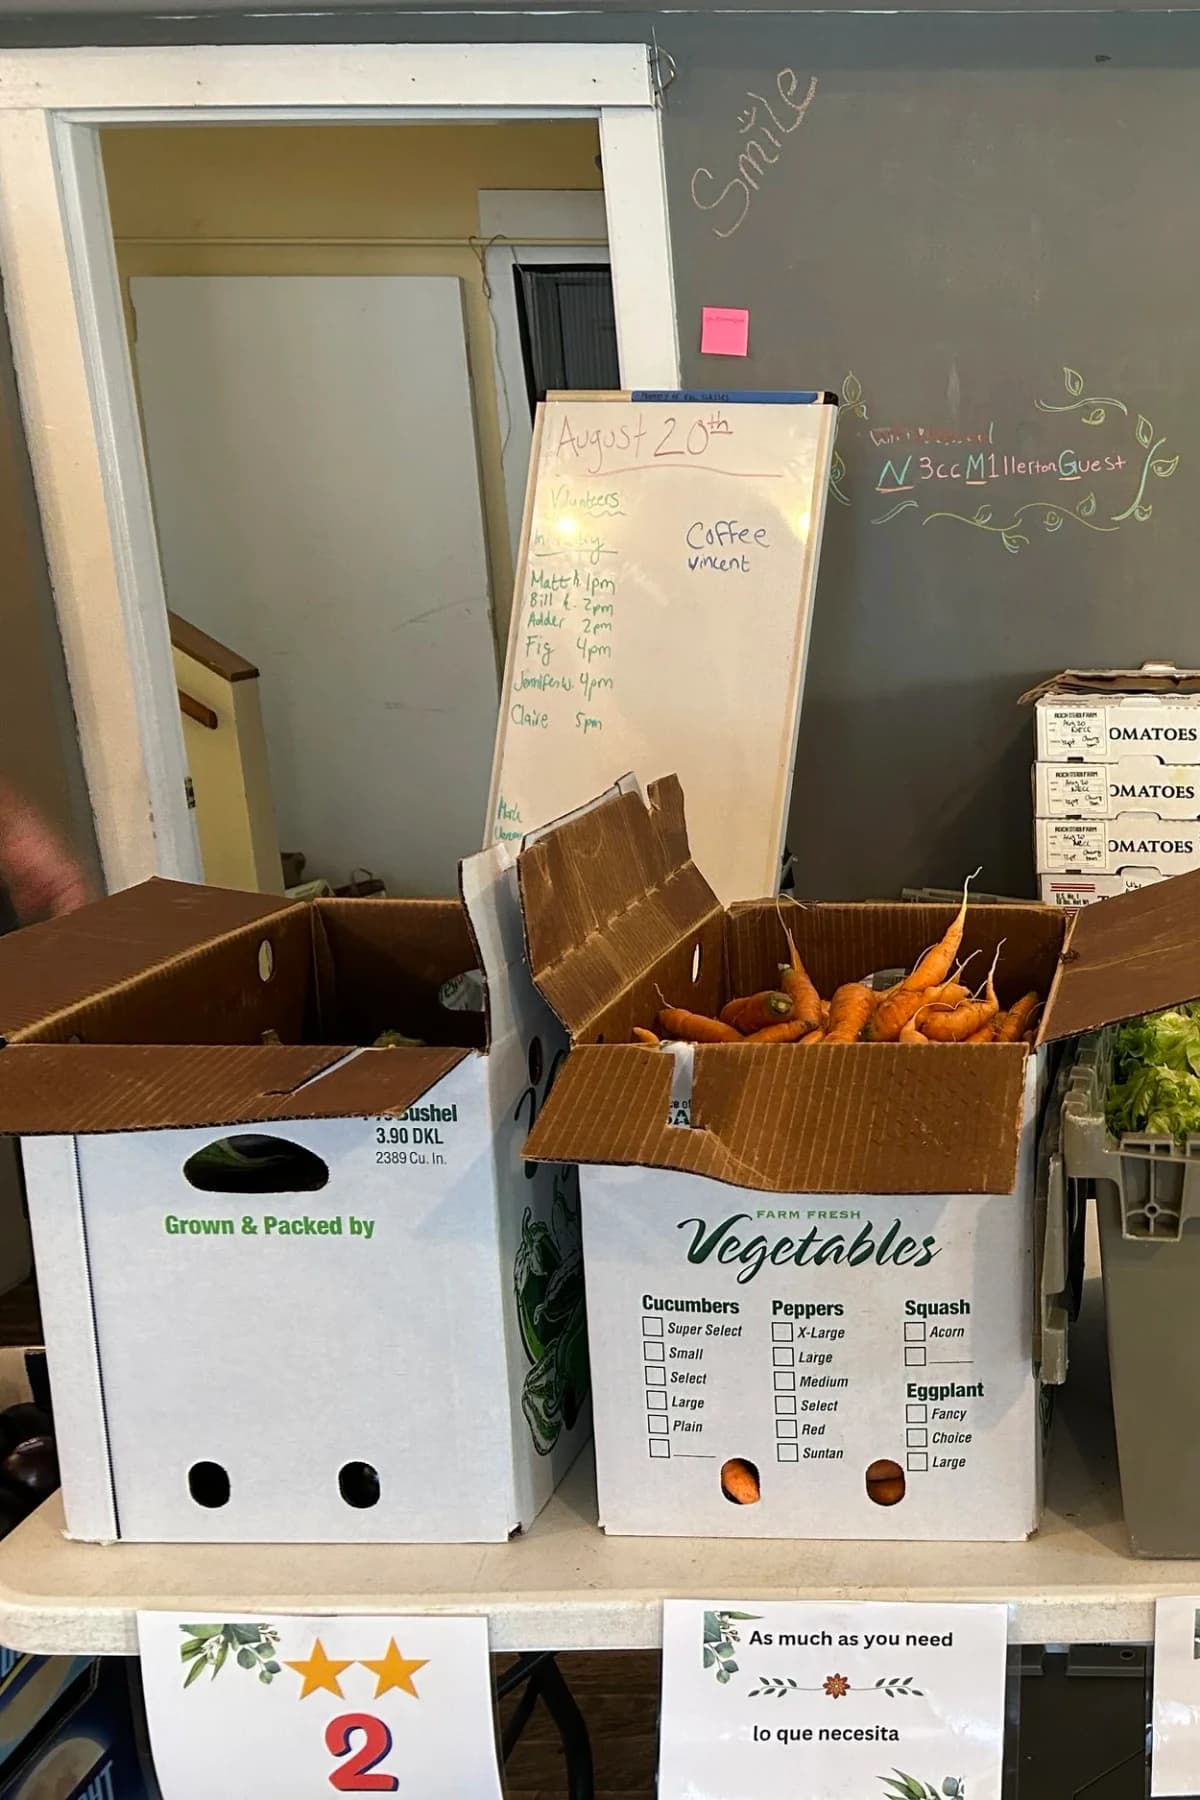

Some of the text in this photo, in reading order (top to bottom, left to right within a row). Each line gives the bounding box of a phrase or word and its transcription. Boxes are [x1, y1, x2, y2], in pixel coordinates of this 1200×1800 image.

[691, 68, 818, 239] Smile
[557, 413, 647, 473] August
[686, 520, 770, 550] Coffee
[530, 591, 552, 608] Bill
[584, 598, 613, 617] 2pm
[582, 618, 612, 635] 2pm
[577, 638, 611, 663] 4pm
[580, 672, 613, 702] 4pm
[510, 704, 602, 734] Claire 5pm
[1109, 727, 1197, 741] OMATOES
[1109, 784, 1195, 799] OMATOES
[1108, 839, 1194, 853] OMATOES
[376, 1127, 444, 1144] 3.90 DKL
[376, 1151, 447, 1165] 2389 Cu. In.
[756, 1210, 861, 1219] FARM FRESH
[165, 1215, 374, 1239] Grown & Packed by
[676, 1213, 942, 1284] Vegetables
[642, 1294, 740, 1314] Cucumbers
[772, 1300, 844, 1318] Peppers
[905, 1299, 970, 1318] Squash
[668, 1323, 743, 1337] Super Select
[797, 1326, 845, 1341] X-Large
[929, 1325, 965, 1338] Acorn
[669, 1347, 704, 1361] Small
[798, 1351, 833, 1365] Large
[670, 1371, 707, 1385] Select
[800, 1375, 848, 1388] Medium
[906, 1381, 984, 1401] Eggplant
[671, 1395, 705, 1411] Large
[801, 1399, 838, 1412] Select
[931, 1408, 967, 1423] Fancy
[673, 1419, 703, 1433] Plain
[801, 1423, 826, 1436] Red
[932, 1431, 972, 1444] Choice
[803, 1447, 844, 1460] Suntan
[932, 1455, 966, 1470] Large
[749, 1630, 953, 1649] As much as you need
[753, 1725, 900, 1745] lo que necesita
[325, 1712, 399, 1792] 2
